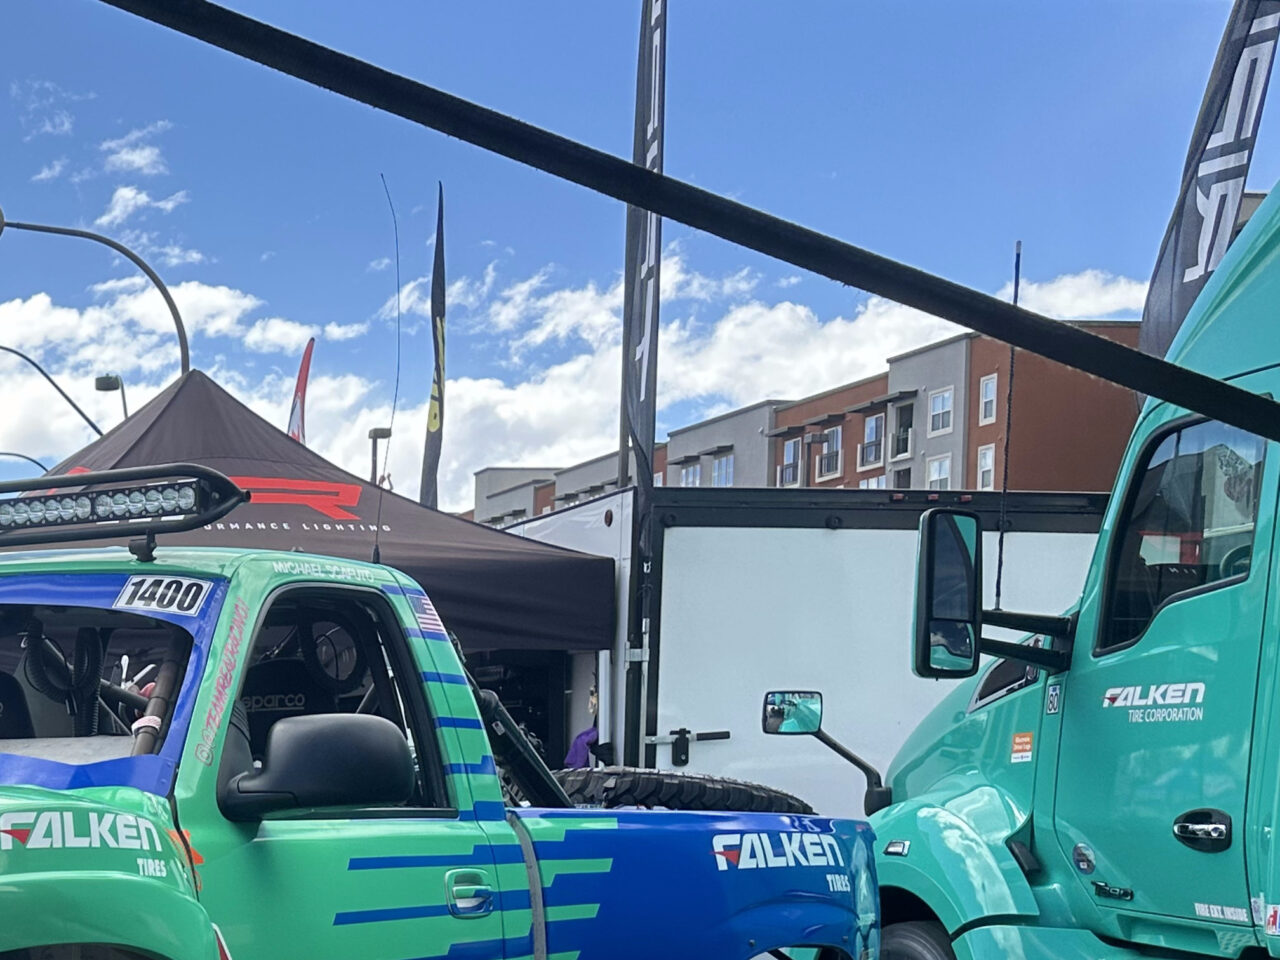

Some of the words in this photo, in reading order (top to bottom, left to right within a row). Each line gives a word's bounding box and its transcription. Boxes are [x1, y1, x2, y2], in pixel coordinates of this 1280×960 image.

[204, 522, 291, 531] ORMANCE
[302, 523, 392, 532] LIGHTING
[273, 561, 324, 577] MICHAEL
[127, 578, 206, 612] 1400
[243, 693, 305, 713] sparco
[1102, 682, 1206, 708] FALKEN
[1128, 709, 1144, 723] TIRE
[1145, 707, 1203, 722] CORPORATION
[711, 832, 845, 871] FALKEN
[136, 858, 167, 877] TIRES
[826, 874, 851, 892] TIRES
